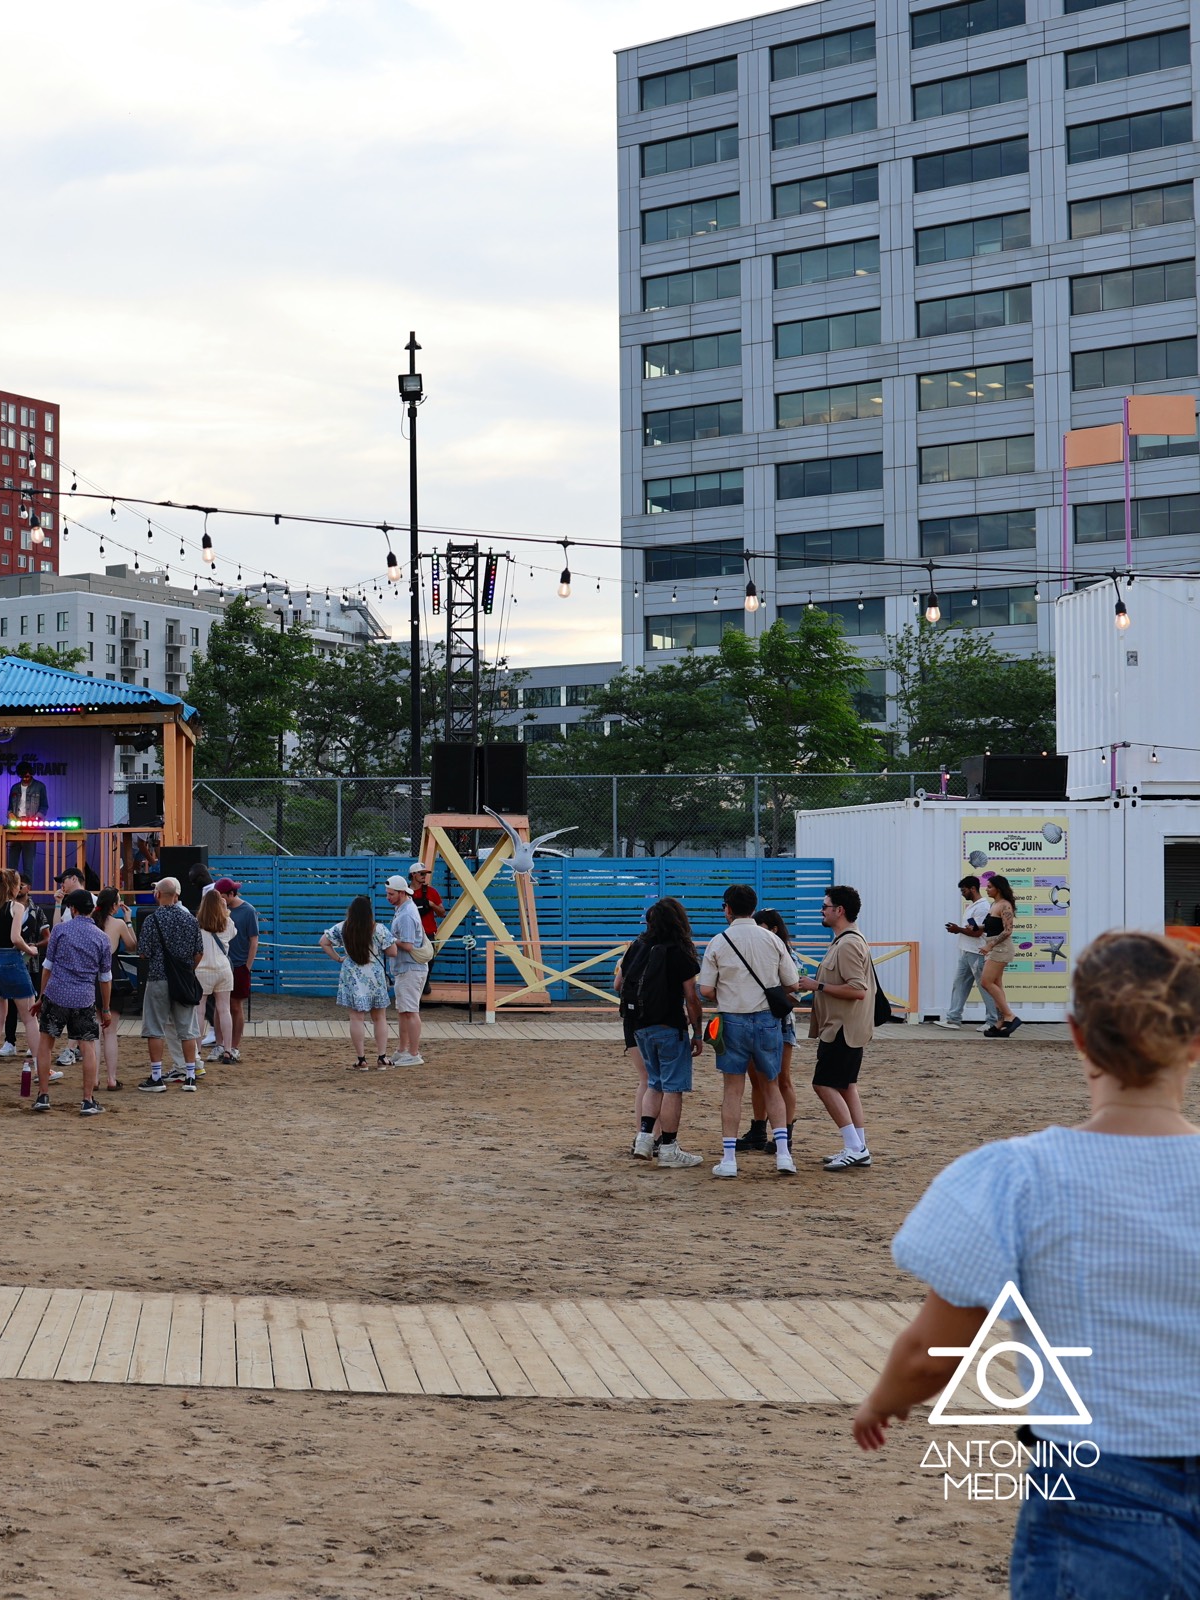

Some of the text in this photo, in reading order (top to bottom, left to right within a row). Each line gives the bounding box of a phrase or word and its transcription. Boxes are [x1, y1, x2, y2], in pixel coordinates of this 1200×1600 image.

[22, 753, 39, 762] au
[7, 762, 68, 776] CURANT
[1022, 841, 1042, 851] JUIN
